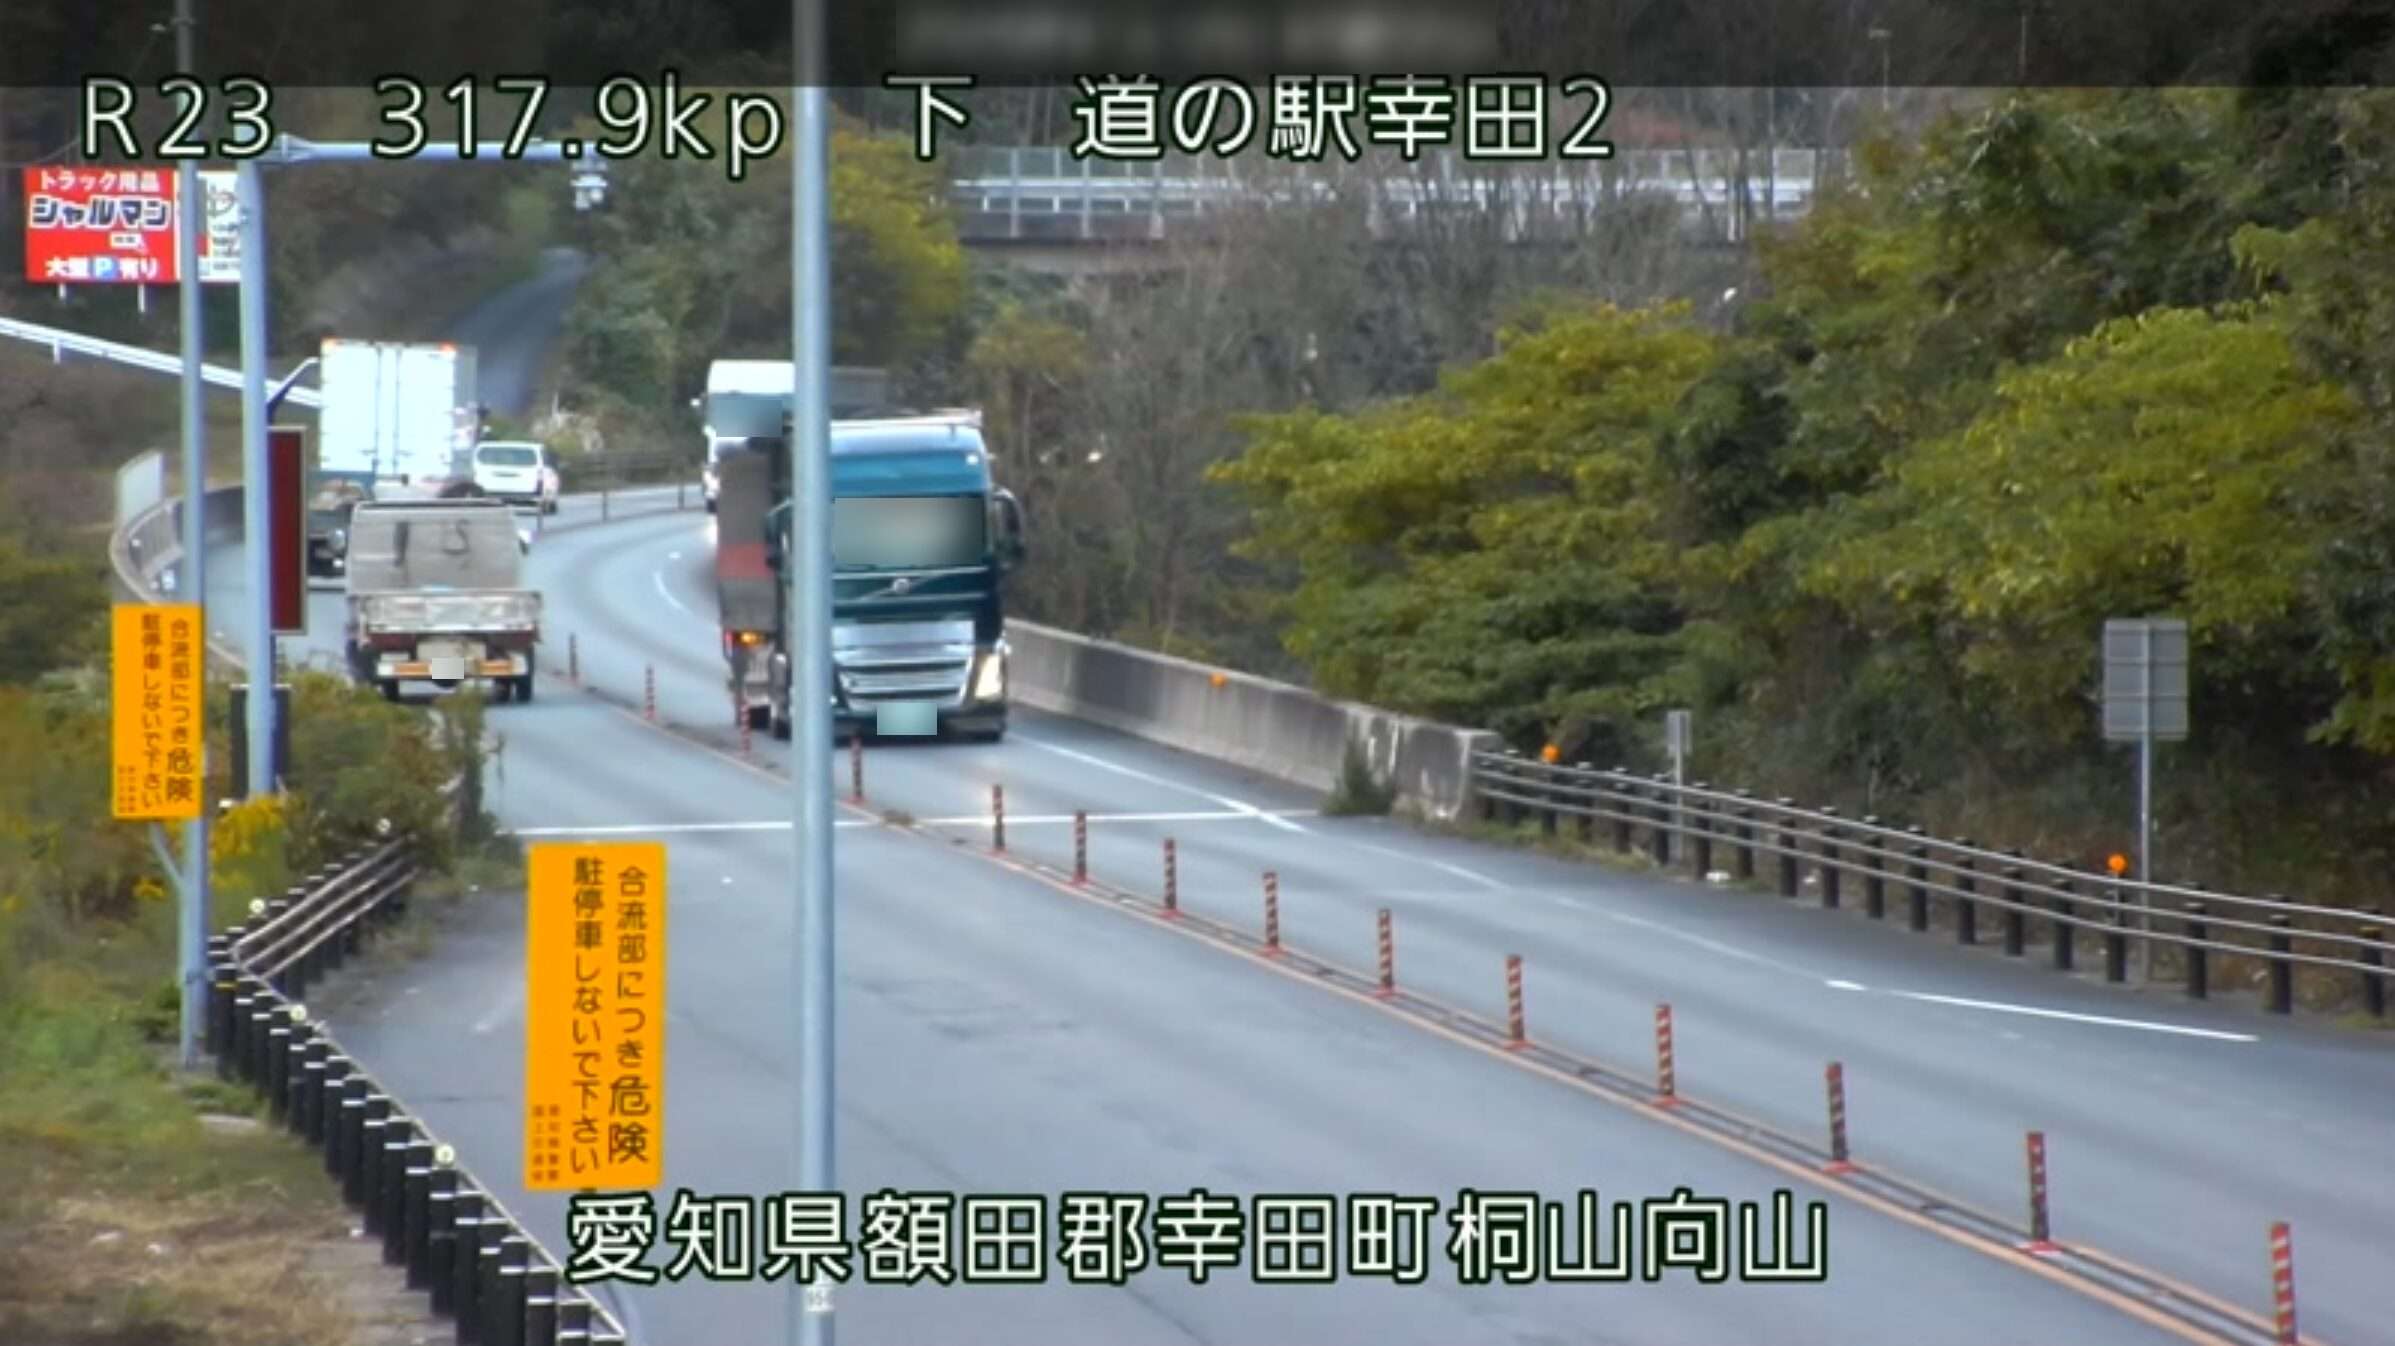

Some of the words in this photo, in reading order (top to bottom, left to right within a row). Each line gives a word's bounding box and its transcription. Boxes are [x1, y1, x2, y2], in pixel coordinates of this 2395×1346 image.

[29, 195, 171, 229] シャルマン
[40, 170, 161, 192] トラック用品
[570, 857, 604, 1175] 駐停車しないで下さい
[608, 865, 651, 1165] 合流部につき危険
